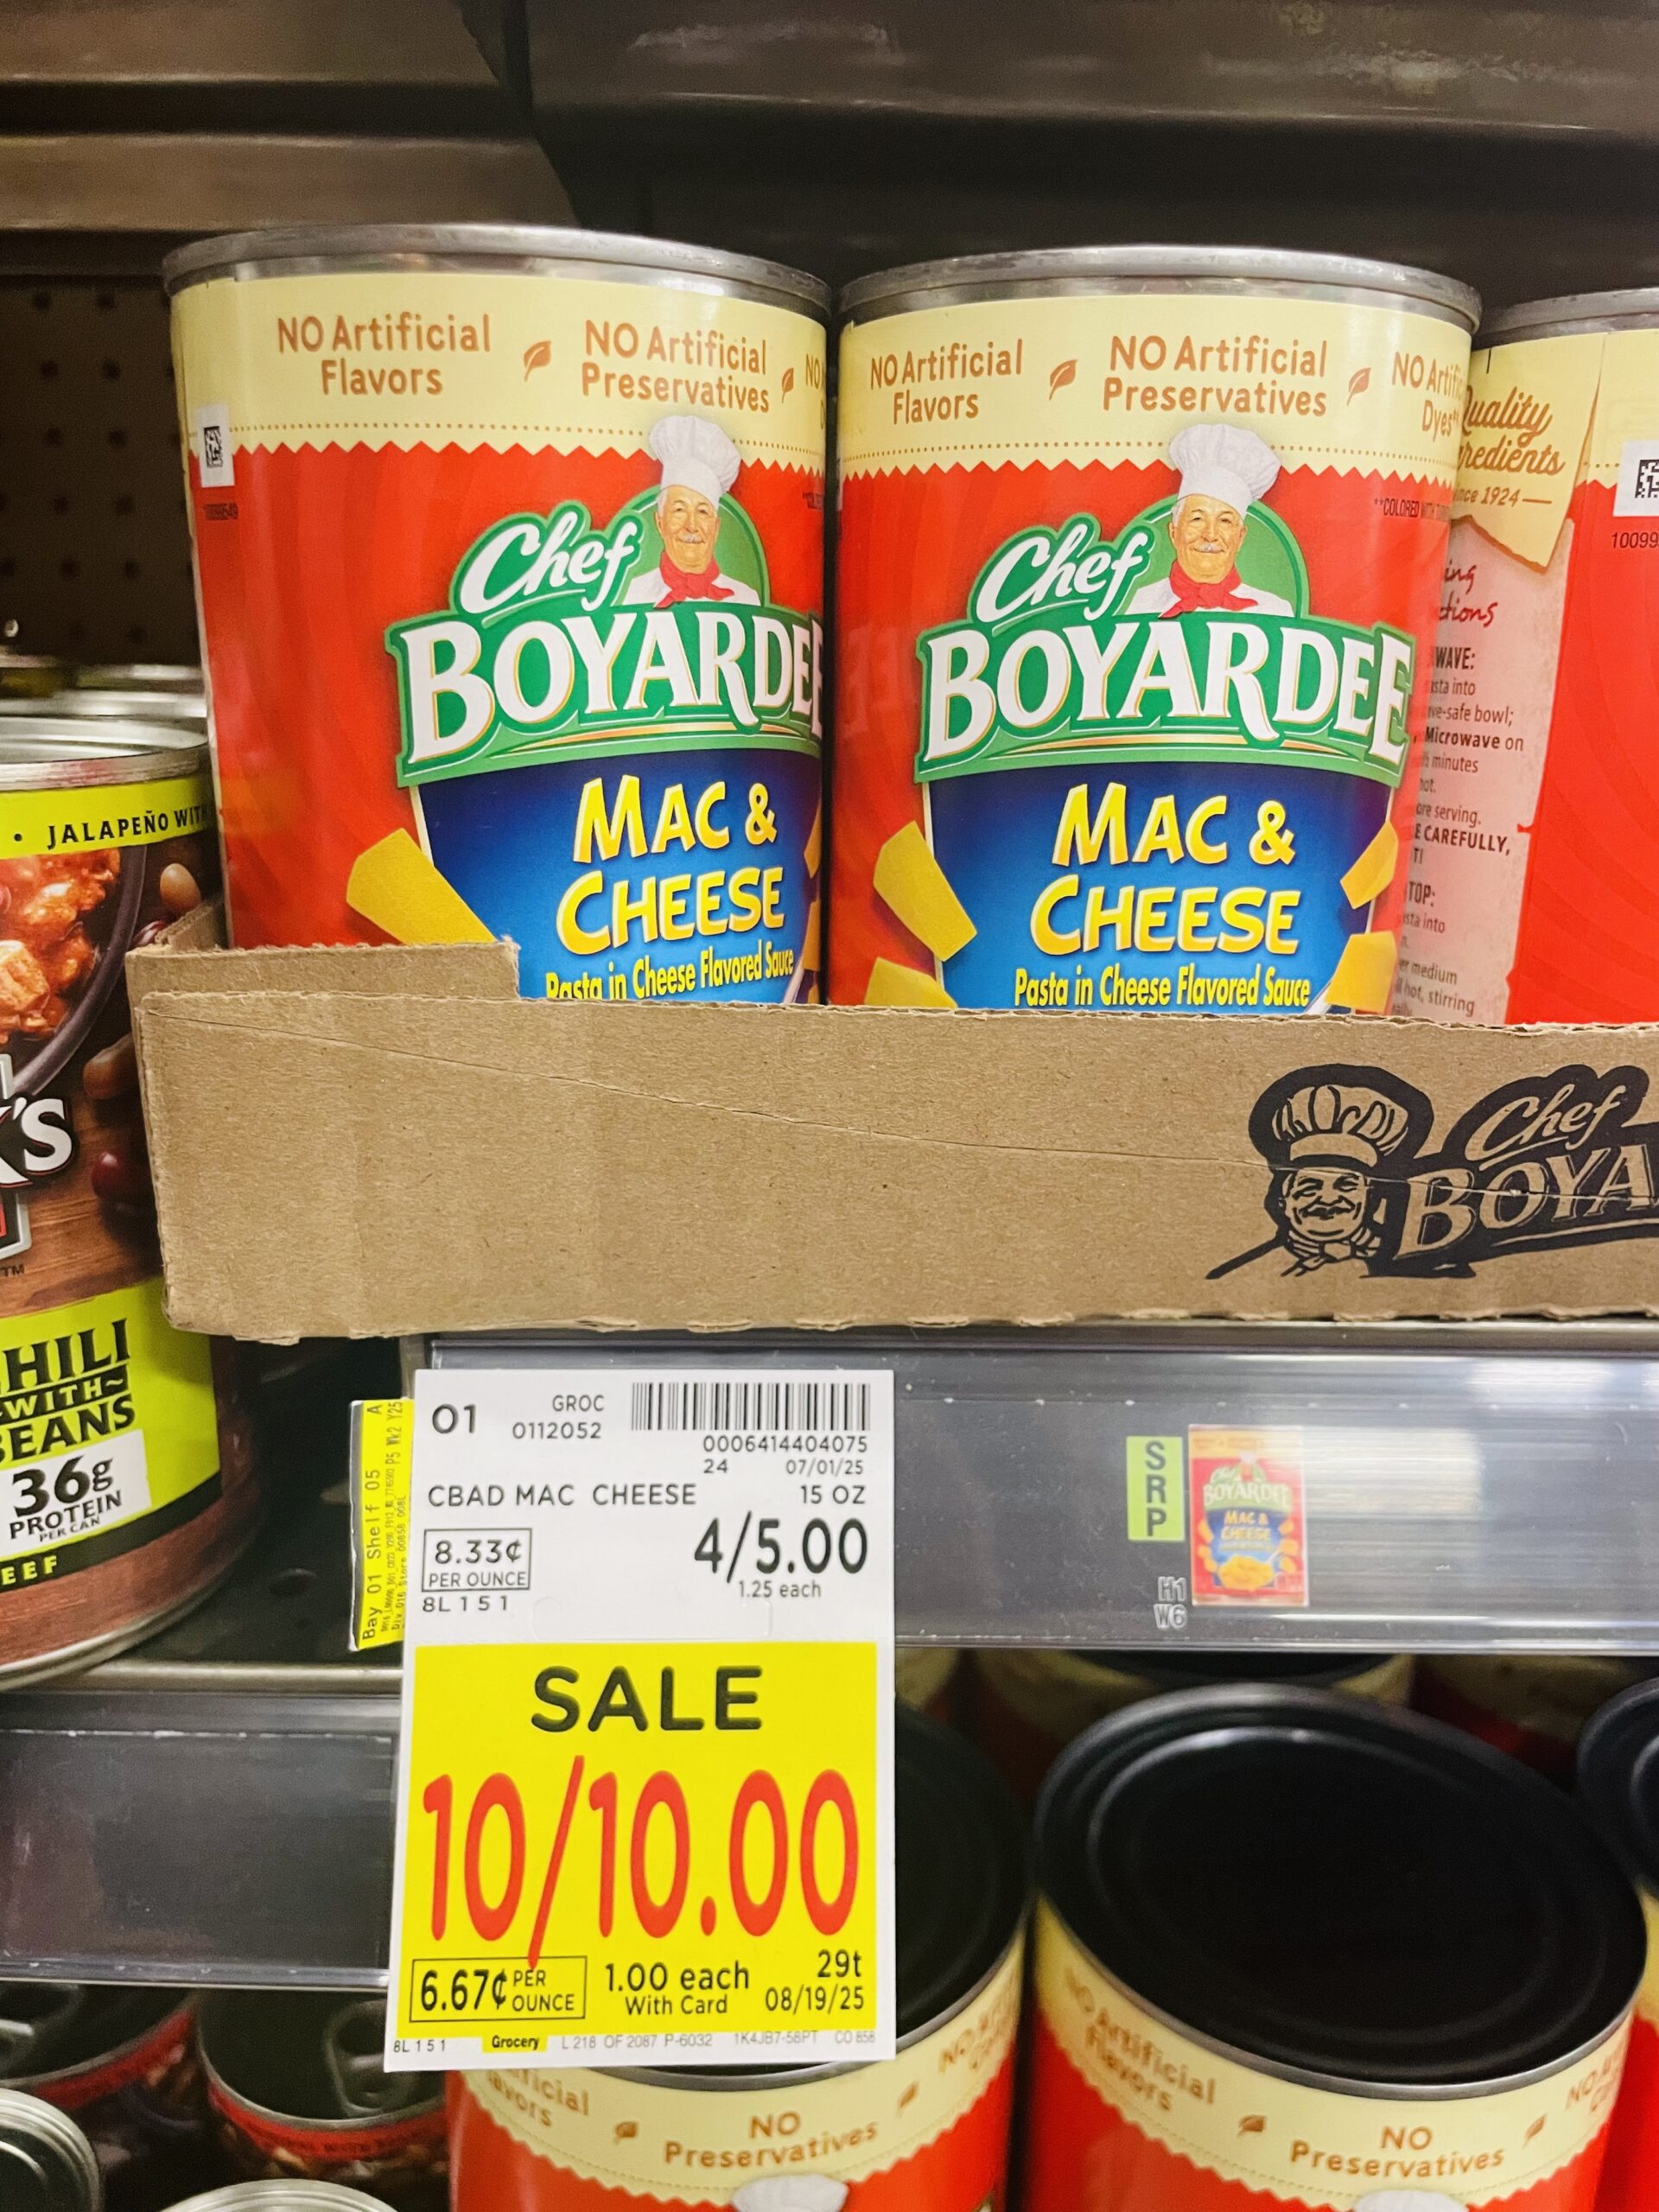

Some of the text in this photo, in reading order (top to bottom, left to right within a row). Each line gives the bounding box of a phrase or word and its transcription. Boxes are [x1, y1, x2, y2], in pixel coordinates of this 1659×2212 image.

[277, 312, 491, 354] NO Artificial
[585, 320, 638, 359] NO
[647, 326, 767, 375] Artificial
[870, 356, 898, 390] NO
[902, 339, 1023, 385] Artificial
[1110, 335, 1328, 378] NO Artificial
[1392, 352, 1424, 389] NO
[321, 360, 443, 396] Flavors
[582, 363, 770, 414] Preservatives
[893, 389, 980, 424] Flavors
[1103, 377, 1328, 417] Preservatives
[1480, 486, 1521, 507] 1924
[1611, 531, 1659, 550] 10099
[460, 511, 638, 614] Chef
[977, 523, 1149, 621] Chef
[925, 620, 1413, 766] BOYARDEE
[1452, 677, 1476, 696] into
[1474, 703, 1514, 728] bowl;
[1425, 726, 1524, 752] Microwave on
[1432, 752, 1479, 773] minutes
[48, 810, 168, 850] JALAPEÑO
[574, 775, 777, 863] MAC &
[1052, 782, 1295, 867] MAC &
[1434, 804, 1482, 829] serving.
[1424, 825, 1510, 856] CAREFULLY,
[556, 868, 785, 955] CHEESE
[1029, 874, 1301, 956] CHEESE
[1423, 912, 1446, 933] into
[545, 939, 794, 1000] Pasta in Cheese Flavored Sauce
[1014, 963, 1311, 1007] Pasta in Cheese Flavored Sauce
[1411, 962, 1458, 985] medium
[1428, 989, 1475, 1017] stirring
[1465, 1084, 1626, 1160] Chef
[1393, 1143, 1656, 1260] BOYA
[2, 1318, 130, 1393] HILI
[552, 1395, 605, 1412] GROC
[512, 1422, 601, 1440] 0112052
[703, 1435, 868, 1453] 0006414404075
[703, 1459, 864, 1477] 24 07/01/25
[12, 1455, 113, 1519] 36g
[428, 1484, 866, 1507] CBAD MAC CHEESE 15 OZ
[10, 1490, 123, 1541] PROTEIN
[40, 1516, 101, 1543] PER CAN
[362, 1404, 383, 1640] Bay 01 Shelf 05 A
[435, 1510, 868, 1584] 8.33¢ 4/5.00
[1, 1554, 58, 1586] EEF
[429, 1571, 526, 1587] PER OUNCE
[738, 1580, 822, 1598] 1.25 each
[1154, 1605, 1187, 1630] W6
[531, 1665, 762, 1732] SALE
[423, 1755, 859, 1971] 10/10.00
[605, 1960, 749, 1993] 1.00 each
[817, 1949, 862, 1980] 29t
[421, 1968, 546, 2012] 6.67¢ PER
[512, 1994, 575, 2012] OUNCE
[626, 1994, 728, 2015] With Card
[765, 1986, 864, 2016] 08/19/25
[492, 2034, 541, 2051] Grocery
[573, 2035, 596, 2050] 218
[604, 2035, 623, 2049] OF
[627, 2034, 658, 2049] 2087
[664, 2034, 713, 2048] P-6032
[1096, 2007, 1216, 2107] Artificial
[749, 2112, 801, 2139] NO
[1382, 2126, 1433, 2151] NO
[664, 2121, 878, 2170] Preservatives
[1290, 2139, 1505, 2178] Preservatives
